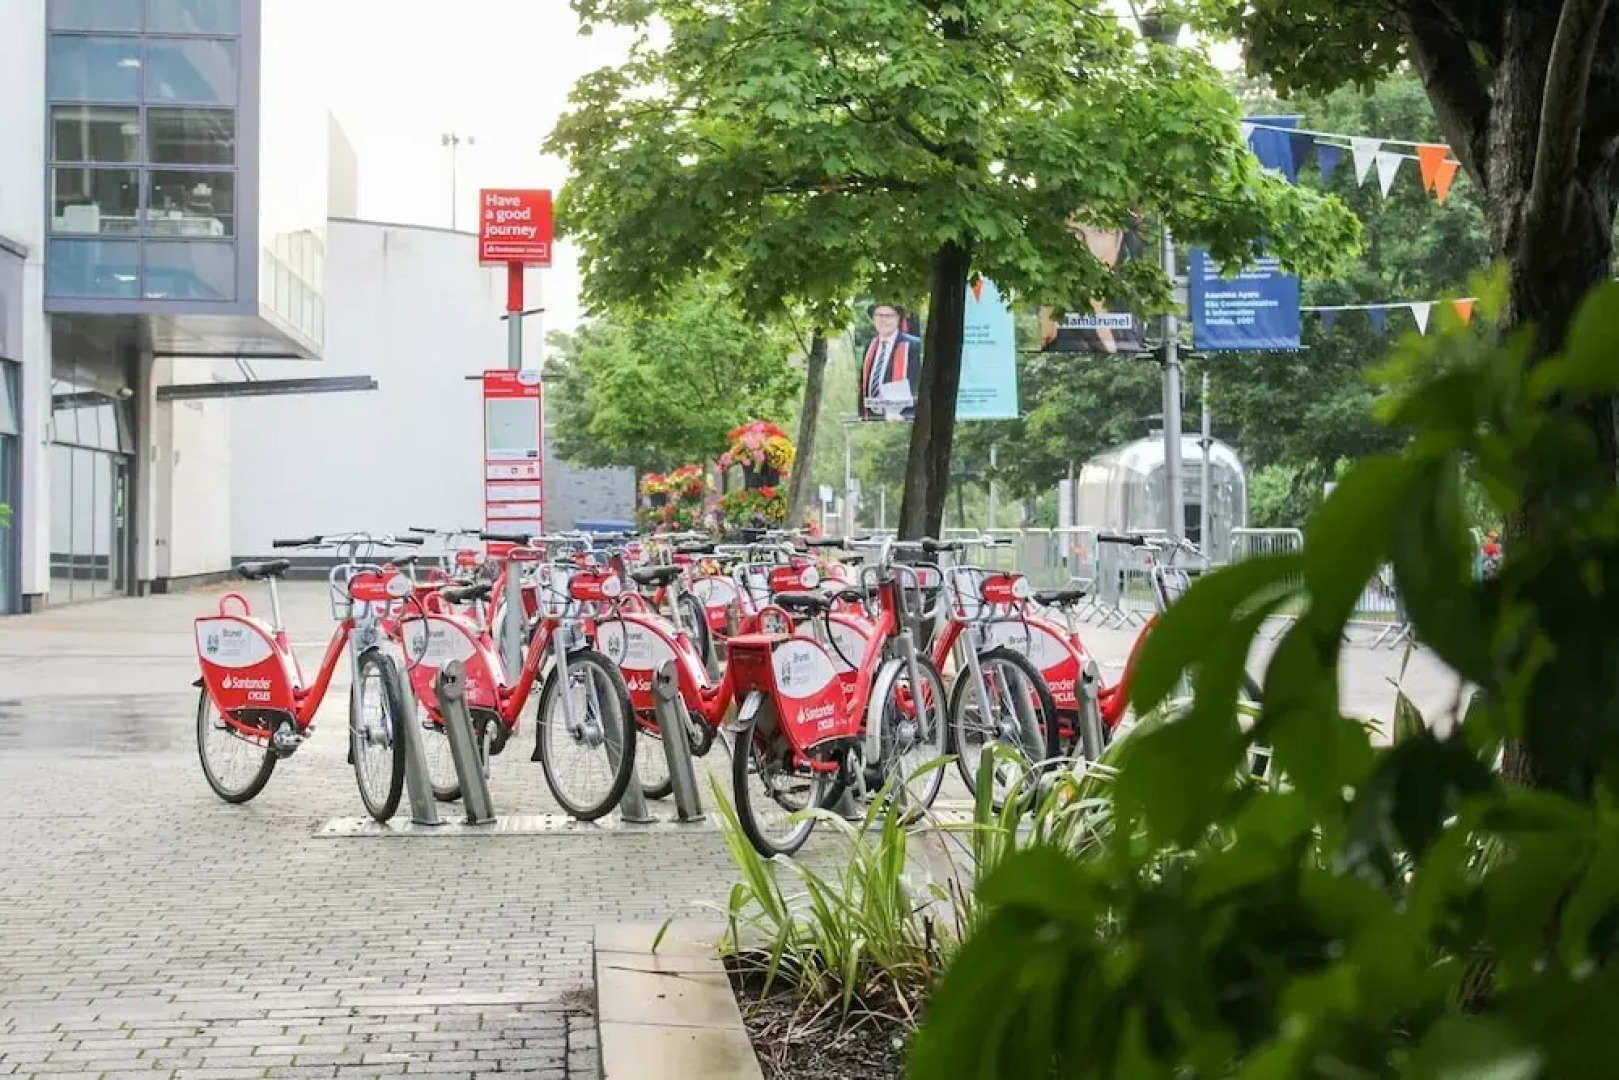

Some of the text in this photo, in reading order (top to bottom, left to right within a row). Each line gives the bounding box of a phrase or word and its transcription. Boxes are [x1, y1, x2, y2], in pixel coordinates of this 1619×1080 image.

[485, 194, 520, 207] Have
[485, 206, 531, 223] a good
[484, 222, 537, 239] journey
[1220, 300, 1279, 308] Communication
[1212, 309, 1256, 317] Information
[232, 676, 271, 689] Santander
[247, 690, 271, 700] CYCLES
[803, 700, 835, 722] Santander
